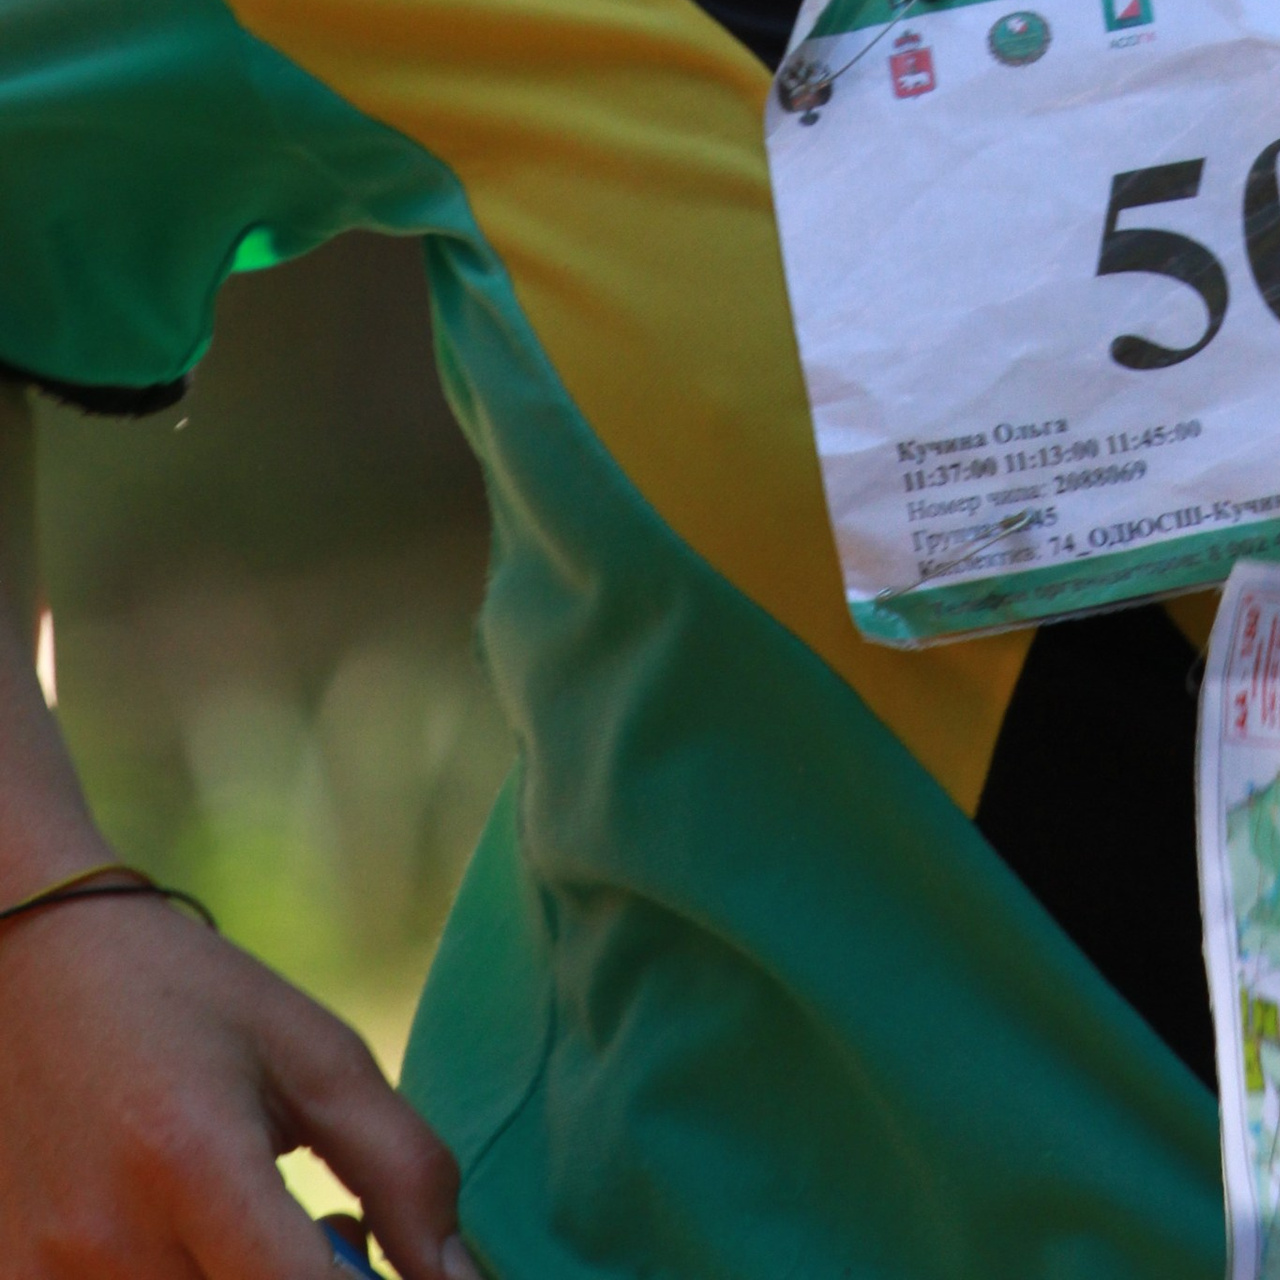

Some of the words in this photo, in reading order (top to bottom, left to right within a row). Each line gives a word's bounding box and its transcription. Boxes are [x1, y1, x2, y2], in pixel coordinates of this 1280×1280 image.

[896, 431, 988, 465] Кучина
[993, 418, 1068, 444] Ольга
[903, 456, 997, 491] 11:37:00
[1004, 438, 1099, 473] 11:13:00
[1106, 419, 1202, 455] 11:45:00
[906, 494, 982, 522] Номер
